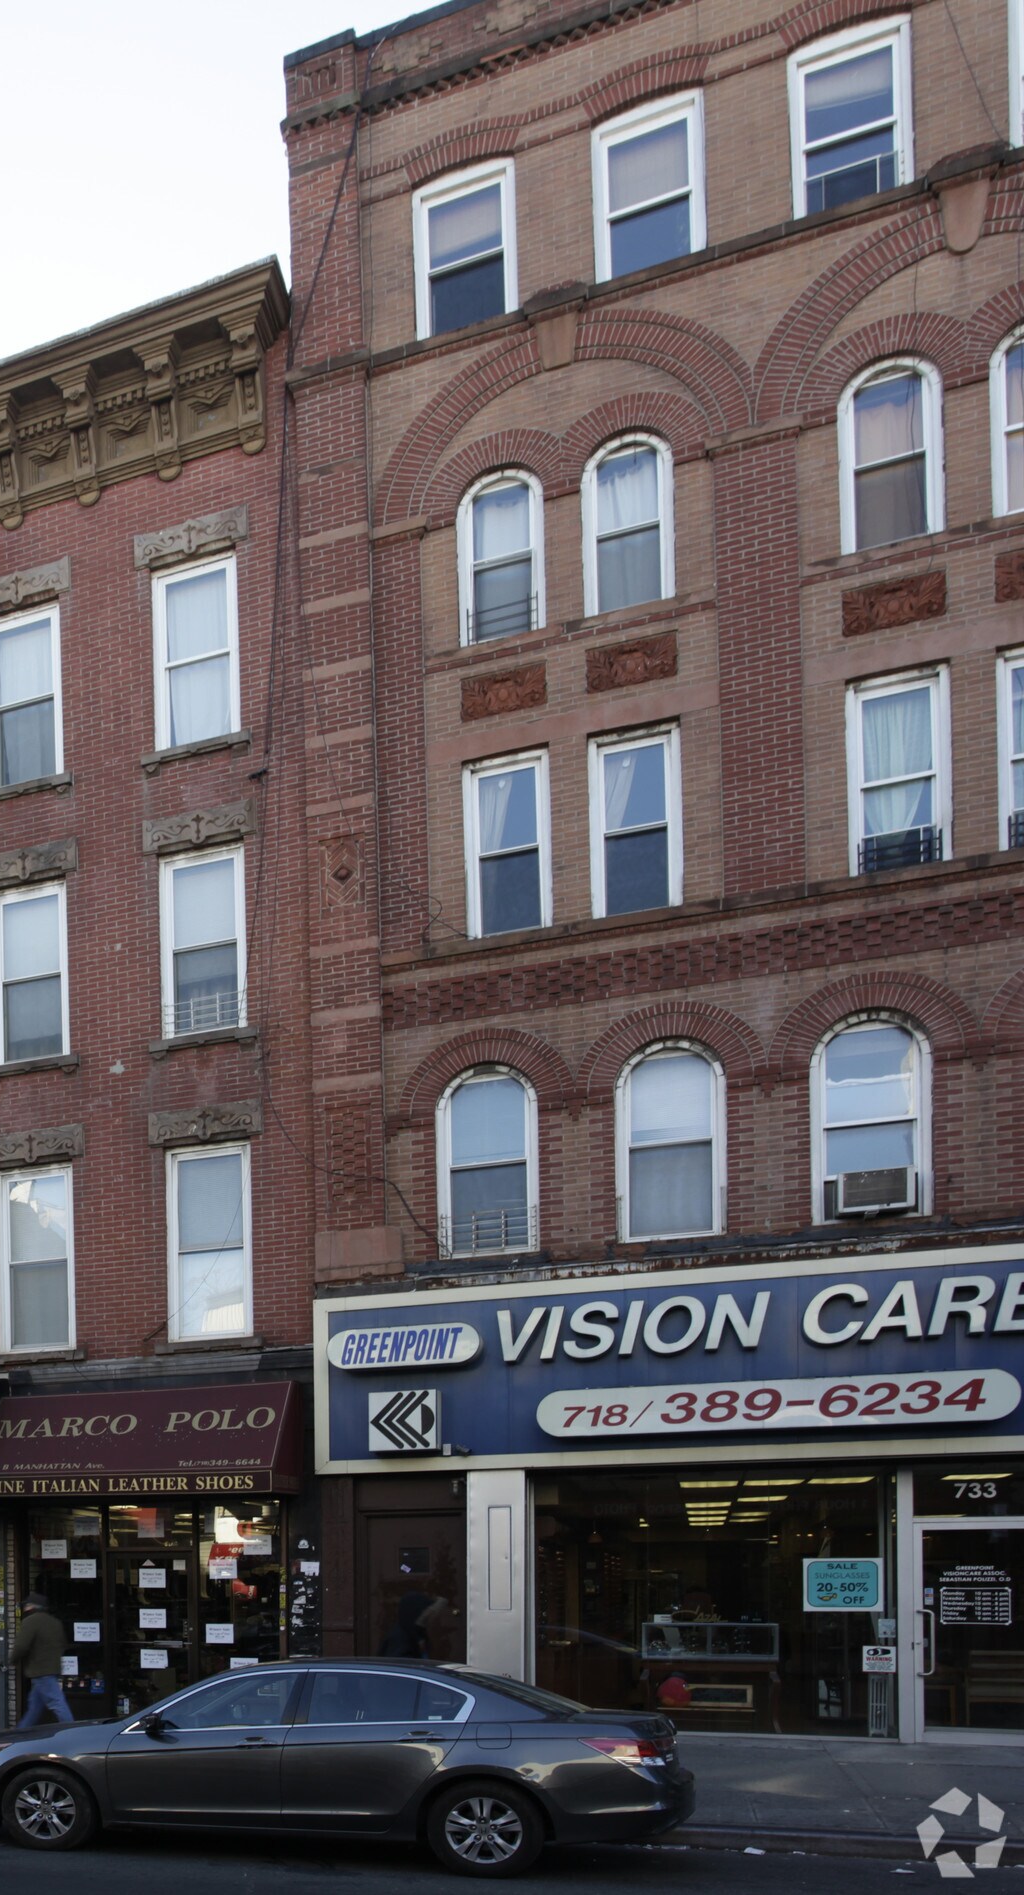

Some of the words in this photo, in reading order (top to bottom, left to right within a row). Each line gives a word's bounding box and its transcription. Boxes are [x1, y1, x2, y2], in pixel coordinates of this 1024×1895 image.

[497, 1291, 770, 1363] VISION
[802, 1272, 1024, 1346] CARE
[341, 1326, 463, 1364] GREENPOINT
[163, 1407, 276, 1432] POLO
[33, 1478, 100, 1492] ITALIAN
[108, 1477, 188, 1492] LEATHER
[196, 1475, 254, 1490] SHOES
[954, 1482, 997, 1499] 733
[816, 1583, 868, 1592] 20-50%
[843, 1596, 864, 1604] OFF
